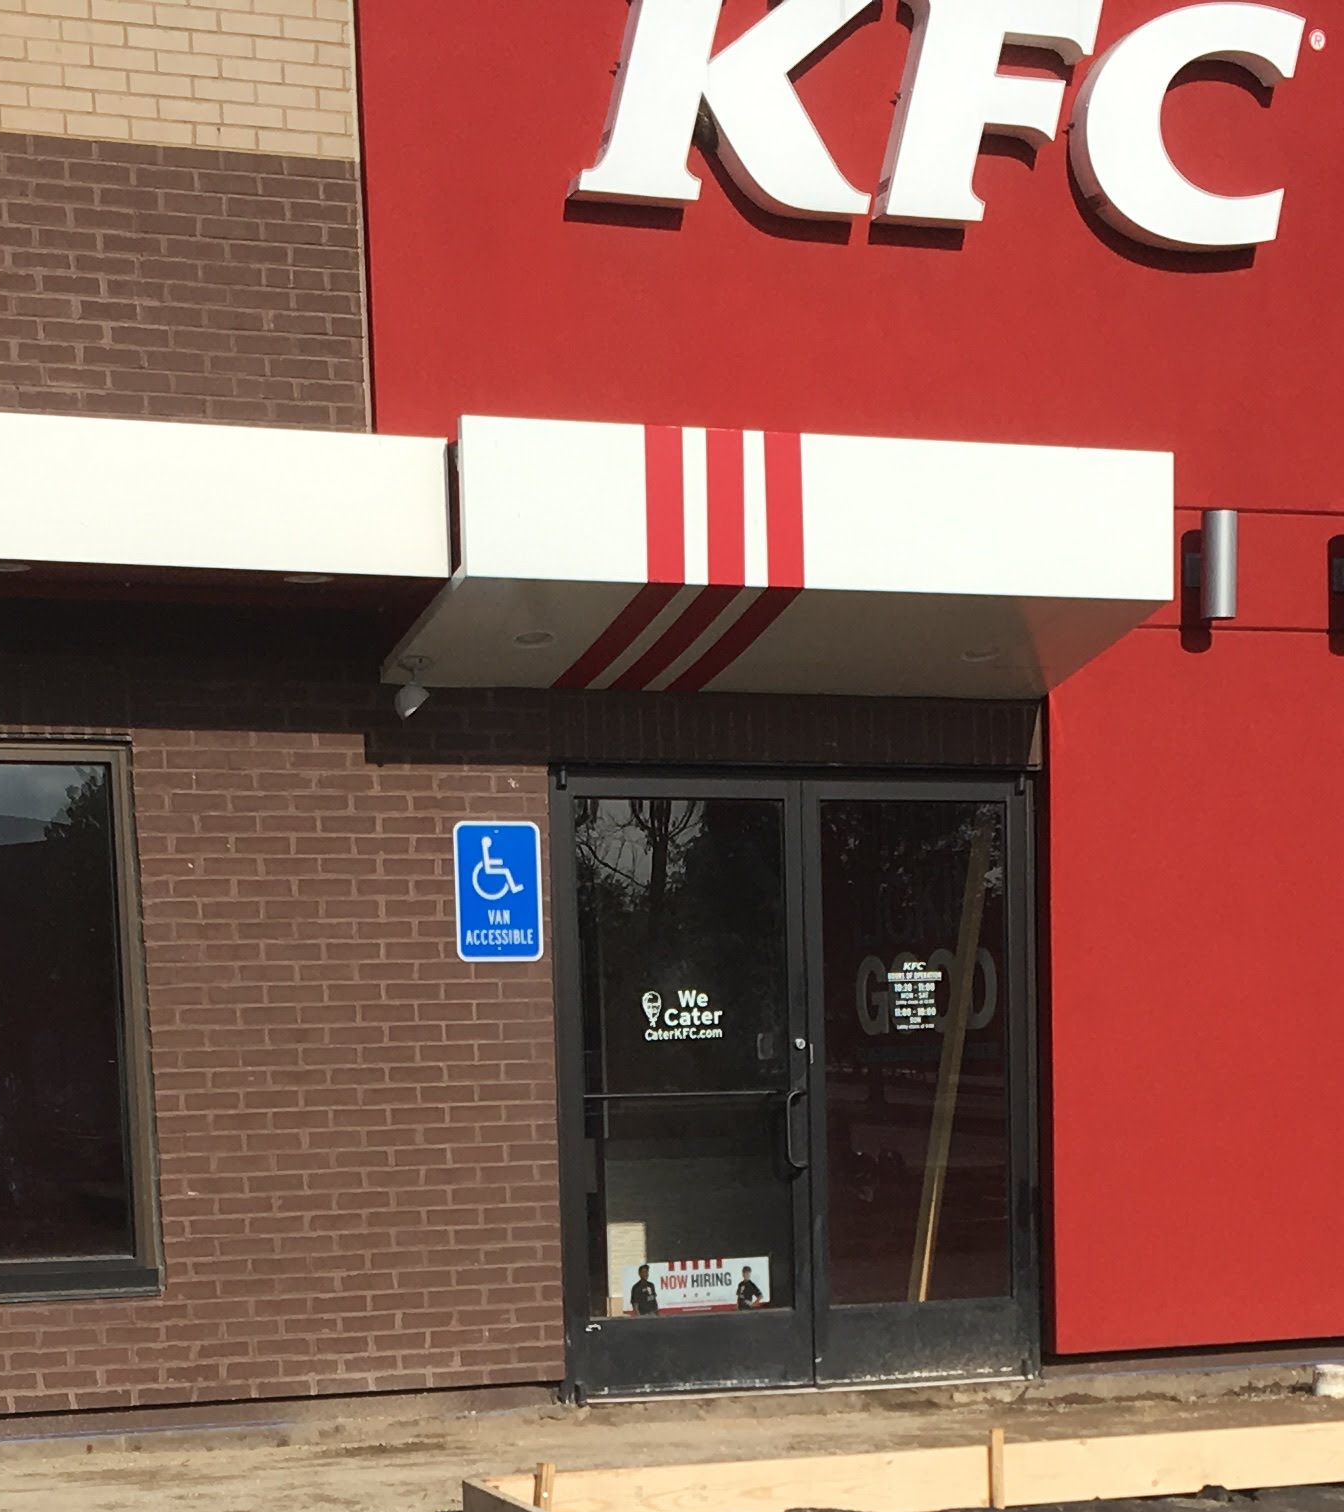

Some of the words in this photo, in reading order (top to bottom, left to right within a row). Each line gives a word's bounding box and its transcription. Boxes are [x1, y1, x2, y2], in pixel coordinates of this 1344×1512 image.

[565, 0, 1306, 249] KFC
[488, 909, 511, 926] VAN
[465, 928, 534, 946] ACCESSIBLE
[902, 961, 927, 971] KFC
[677, 989, 709, 1008] We
[664, 1007, 723, 1027] Cater
[644, 1027, 723, 1041] CaterKFC.com
[660, 1274, 689, 1290] NOW
[690, 1271, 733, 1289] HIRING
